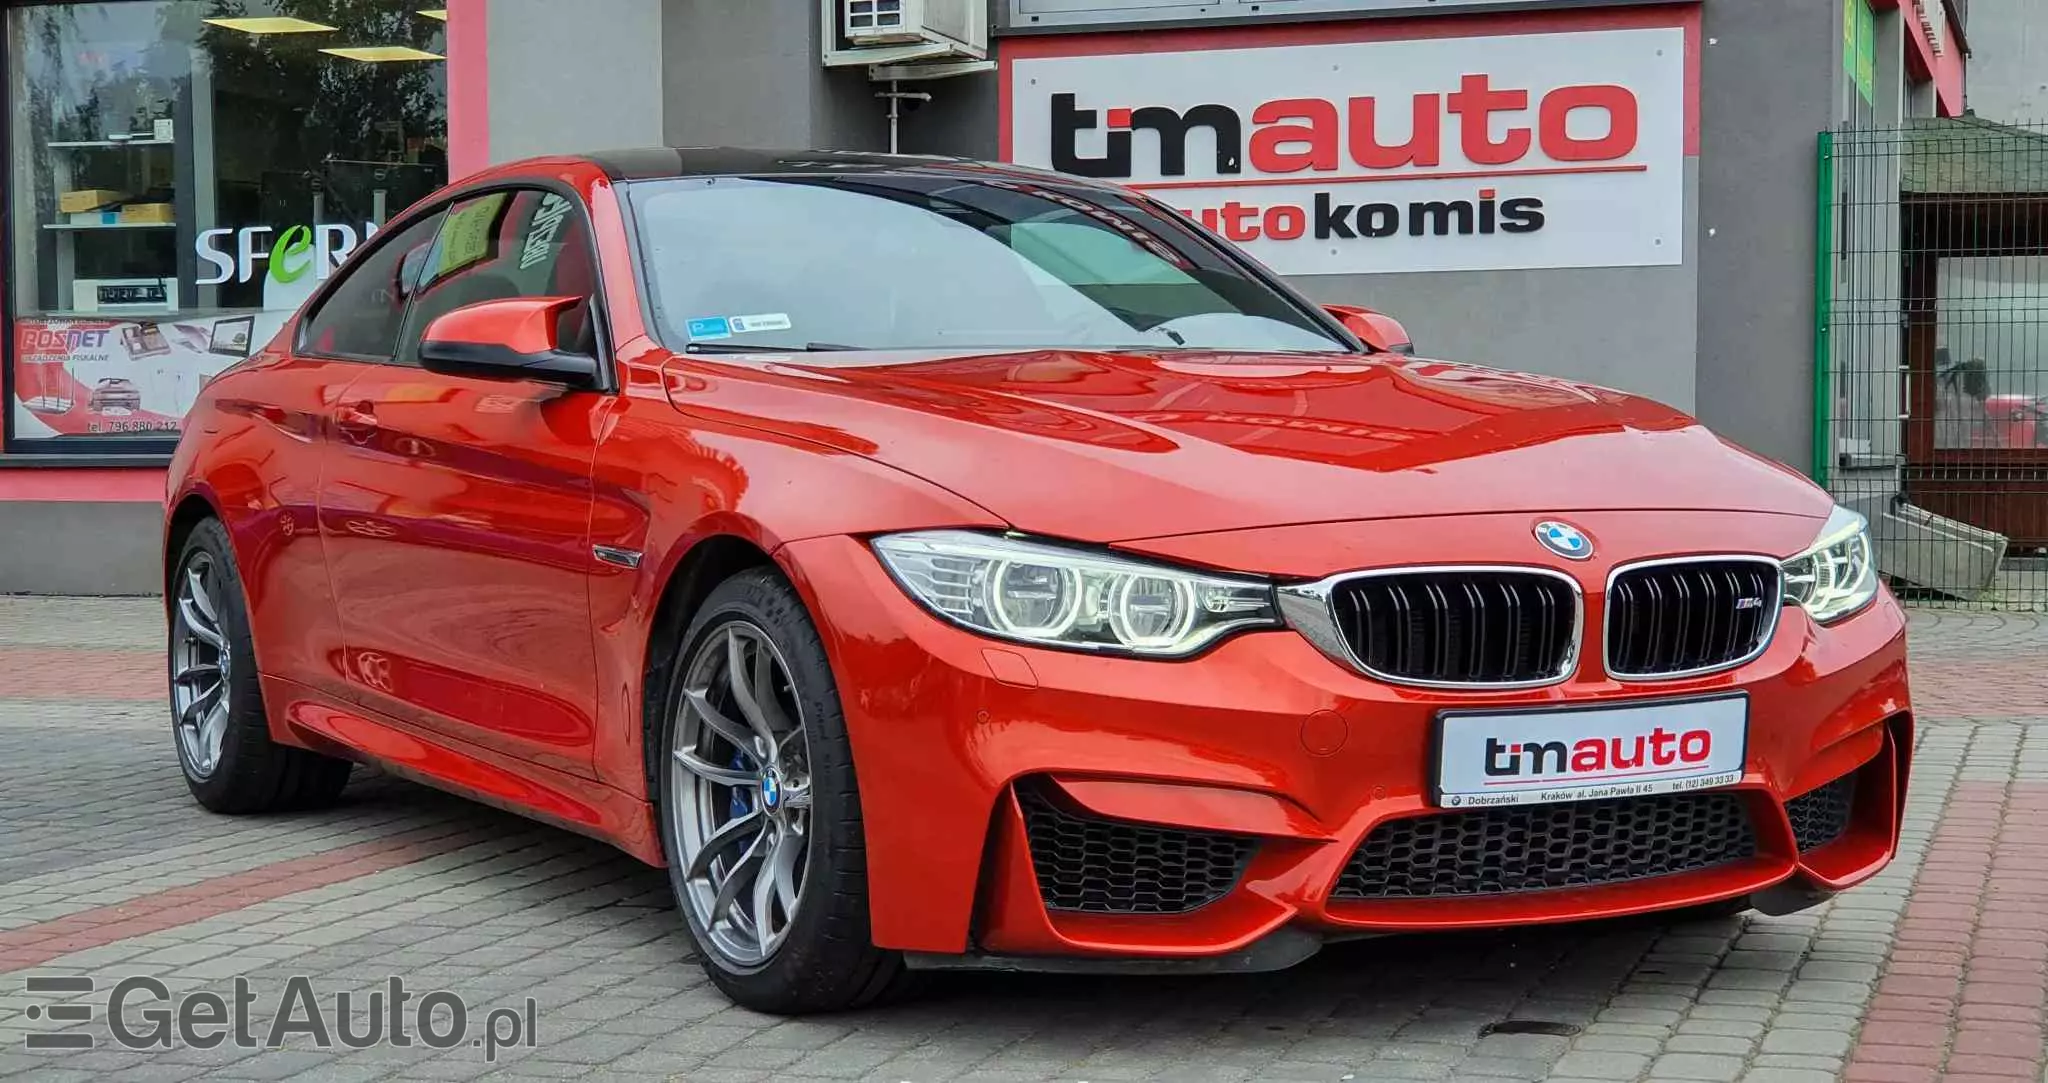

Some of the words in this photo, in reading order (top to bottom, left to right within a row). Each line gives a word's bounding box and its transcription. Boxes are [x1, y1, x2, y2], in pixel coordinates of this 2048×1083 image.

[1051, 74, 1638, 178] timauto
[1179, 189, 1545, 242] tokomis
[195, 222, 381, 285] SFeR
[108, 421, 129, 432] 796
[1485, 727, 1712, 776] timauto
[1467, 794, 1519, 806] Dobrzański
[1541, 790, 1573, 801] Kraków
[1589, 787, 1608, 797] Jana
[1610, 785, 1635, 796] Pawła
[1642, 783, 1653, 793] 45
[1685, 779, 1699, 790] (12)
[1715, 776, 1724, 785] 33
[1725, 774, 1734, 783] 33
